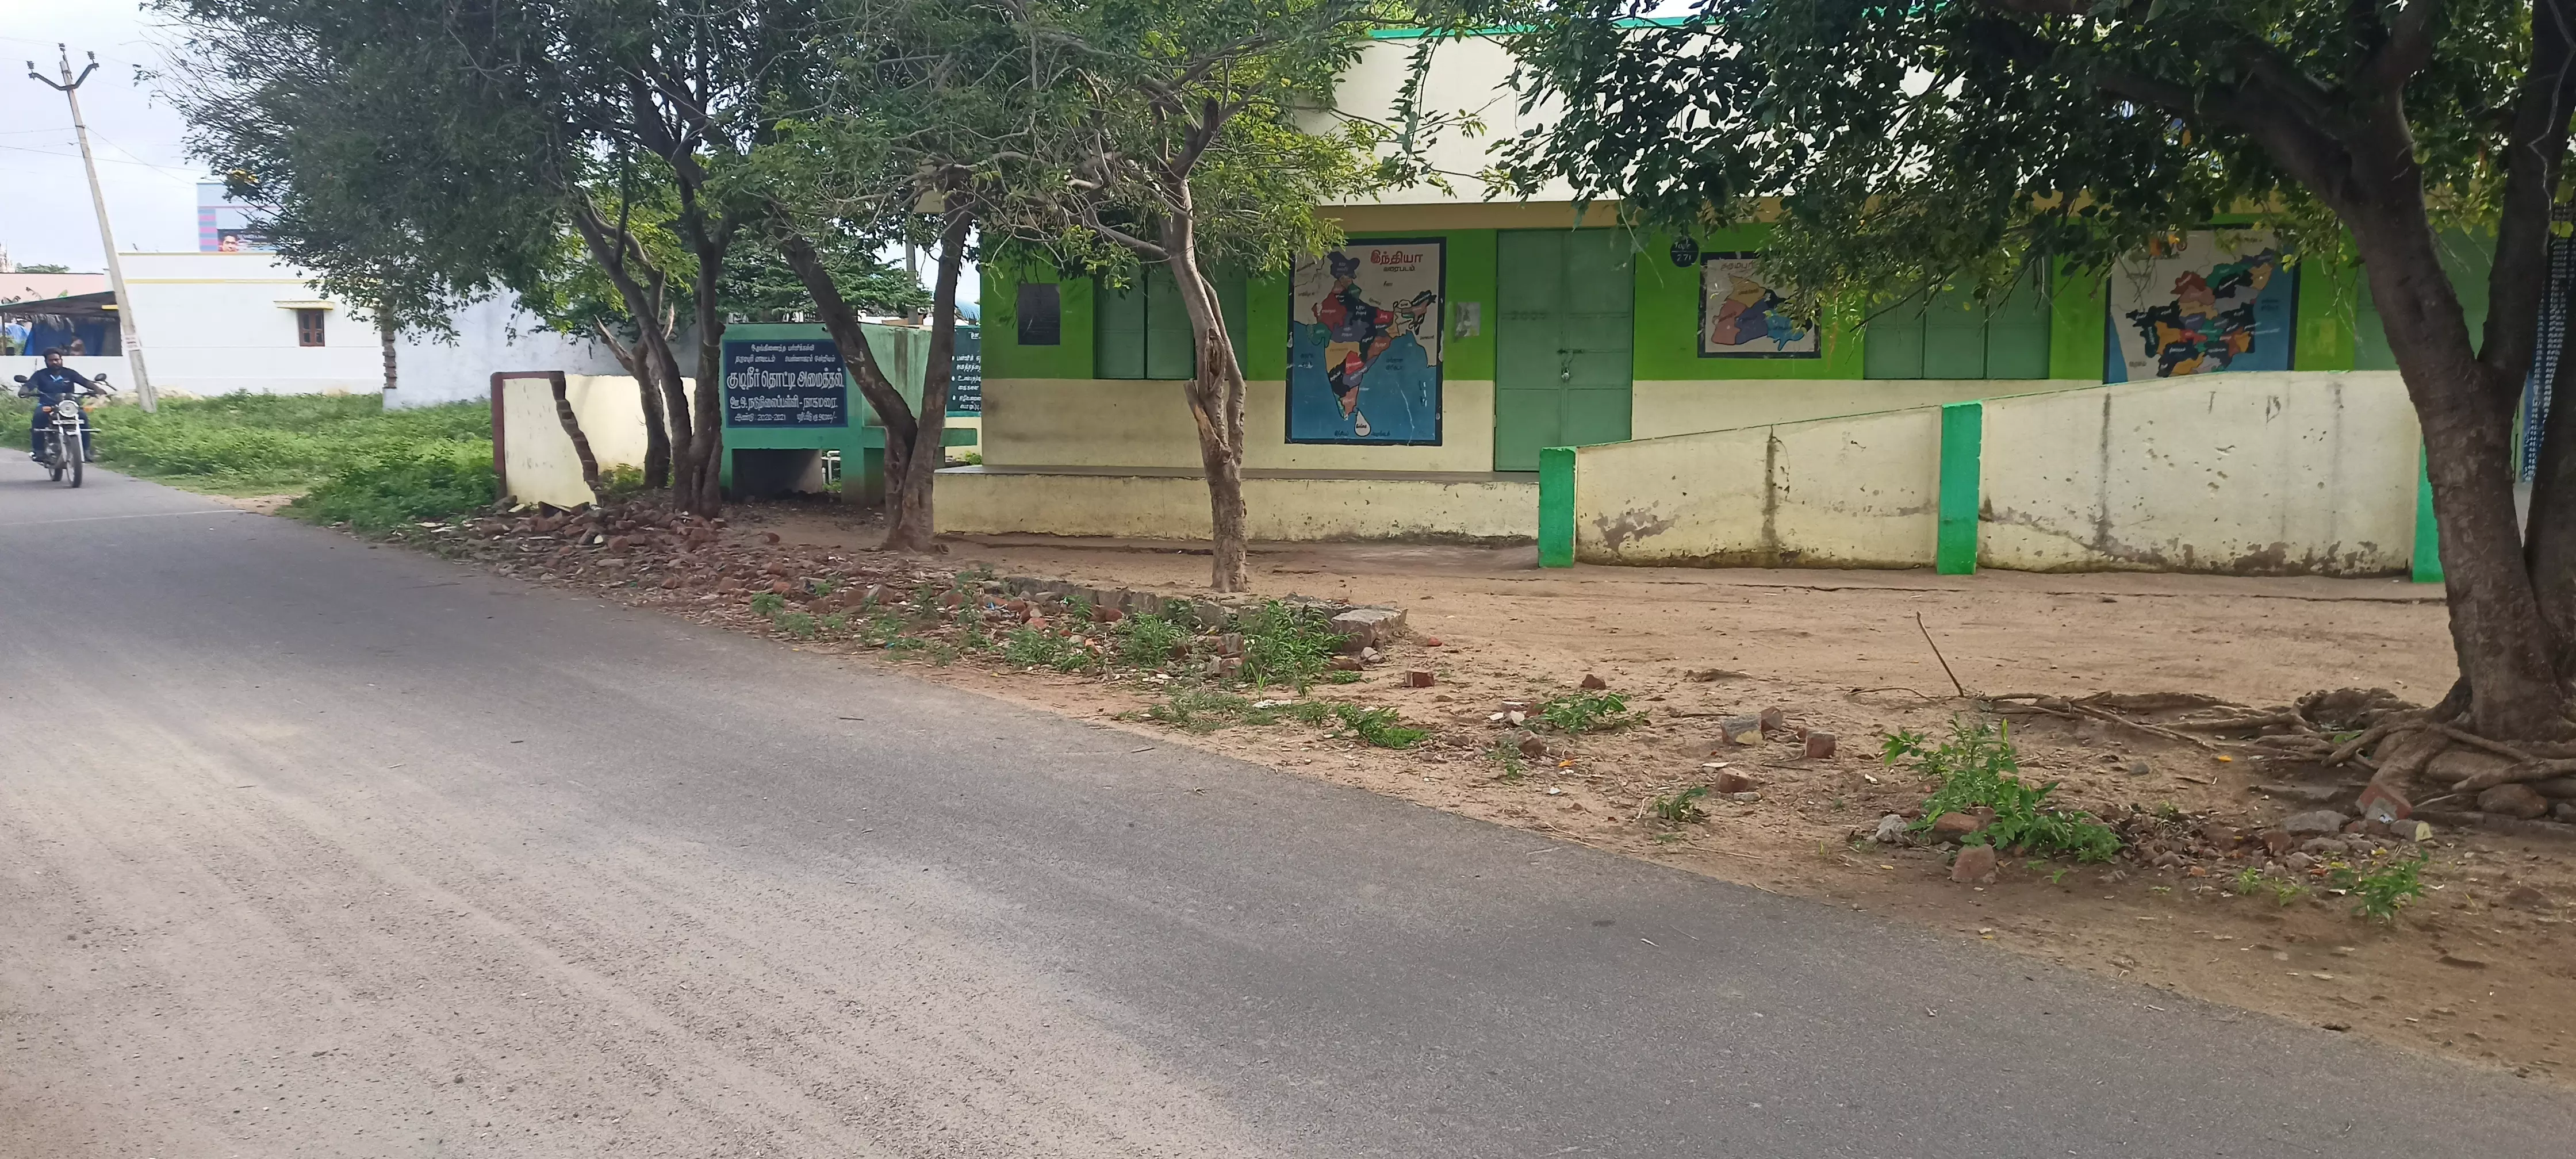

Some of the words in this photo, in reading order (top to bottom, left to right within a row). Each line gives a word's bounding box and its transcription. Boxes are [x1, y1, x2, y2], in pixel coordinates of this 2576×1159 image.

[1370, 249, 1423, 265] இந்தியா
[1383, 264, 1416, 273] வரைபடம்
[727, 367, 760, 390] குடிநீர்
[761, 370, 796, 390] தொட்டி
